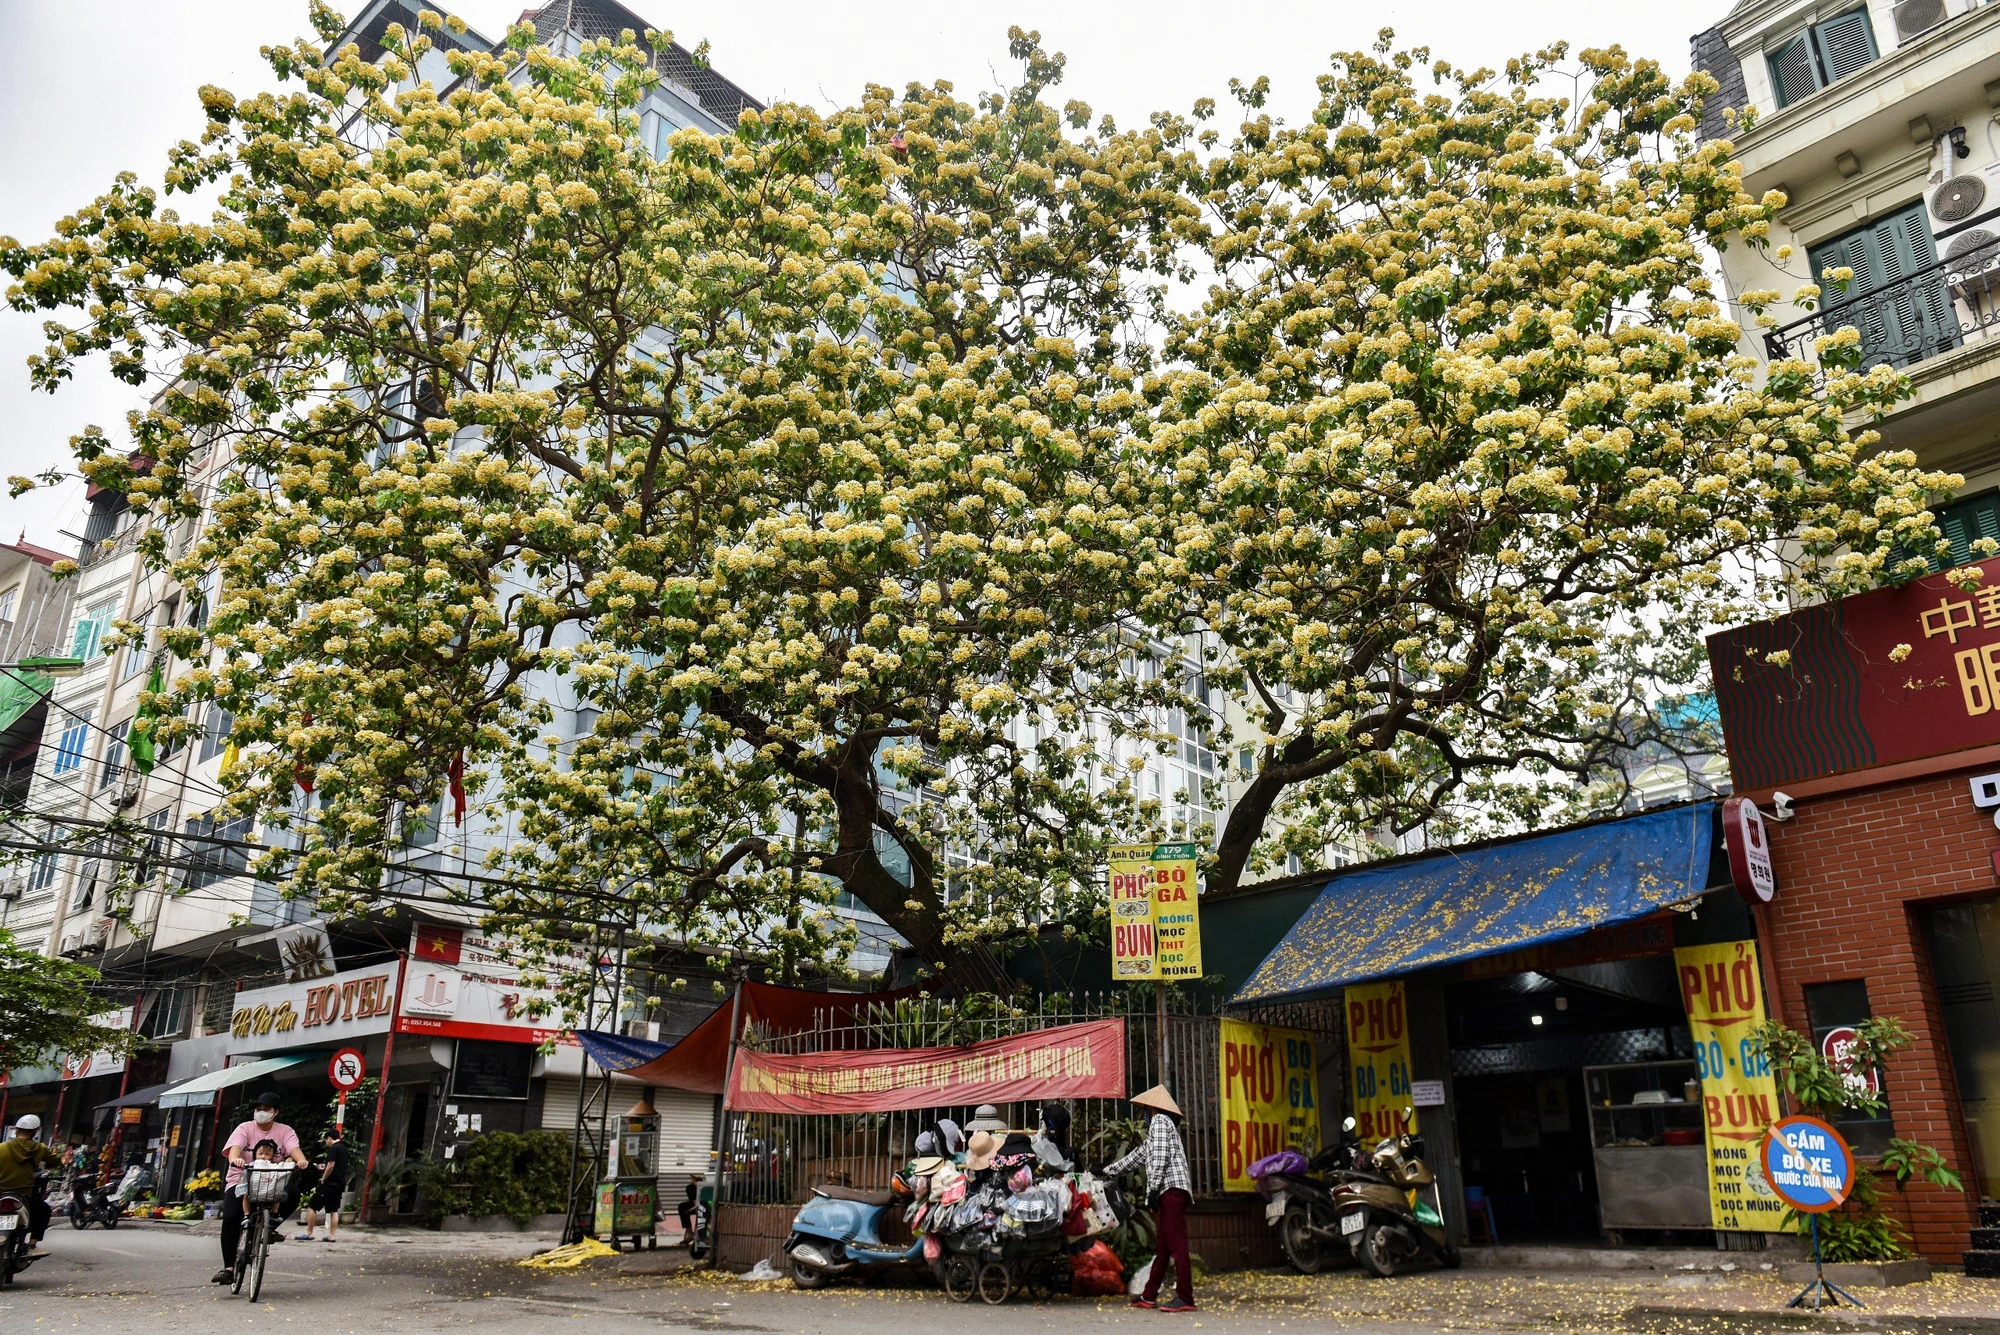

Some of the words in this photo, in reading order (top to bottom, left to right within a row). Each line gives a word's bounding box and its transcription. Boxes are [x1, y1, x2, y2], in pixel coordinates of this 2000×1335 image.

[1111, 850, 1127, 859] Anh
[1129, 850, 1151, 861] Quân
[1163, 846, 1182, 854] 179
[1156, 865, 1186, 884] BÒ
[1157, 884, 1187, 903] GÀ
[1158, 914, 1194, 924] MÓNG
[1115, 918, 1152, 957] BÚN
[1160, 928, 1185, 939] MỌC
[1160, 940, 1185, 951] THỊT
[1161, 954, 1184, 964] DỌC
[1161, 965, 1197, 975] MÙNG
[1680, 943, 1756, 1015] PHỞ
[302, 974, 393, 1028] HOTEL
[1350, 982, 1403, 1043] PHỞ
[1286, 1033, 1311, 1070] BÒ
[1694, 1031, 1724, 1080] BÒ
[831, 1066, 860, 1094] SÀNG
[862, 1065, 893, 1093] CHỮA
[896, 1061, 930, 1088] CHÁY
[931, 1061, 953, 1092] KỊP
[957, 1051, 985, 1084] THỜI
[988, 1049, 1006, 1082] VÀ
[1009, 1047, 1027, 1081] CÓ
[1030, 1045, 1061, 1084] HIỆU
[1064, 1037, 1096, 1079] QUẢ.
[1225, 1027, 1274, 1104] PHỞ
[1356, 1056, 1377, 1098] BÒ
[1389, 1055, 1411, 1096] GÀ
[1288, 1071, 1314, 1109] GÀ
[1705, 1088, 1771, 1128] BÚN
[1359, 1104, 1409, 1139] BÚN
[1226, 1108, 1279, 1179] BÚN
[1787, 1129, 1825, 1151] CẤM
[1713, 1146, 1747, 1160] MÓNG
[1782, 1151, 1805, 1170] ĐỖ
[1810, 1157, 1832, 1174] XE
[1715, 1166, 1741, 1179] MỌC
[1773, 1170, 1801, 1186] TRƯỚC
[1803, 1170, 1821, 1187] CỬA
[1822, 1174, 1843, 1190] NHÀ
[620, 1191, 651, 1205] MÍA
[1717, 1182, 1741, 1196] THỊT
[1721, 1200, 1744, 1213] DỌC
[1746, 1198, 1781, 1212] MÙNG
